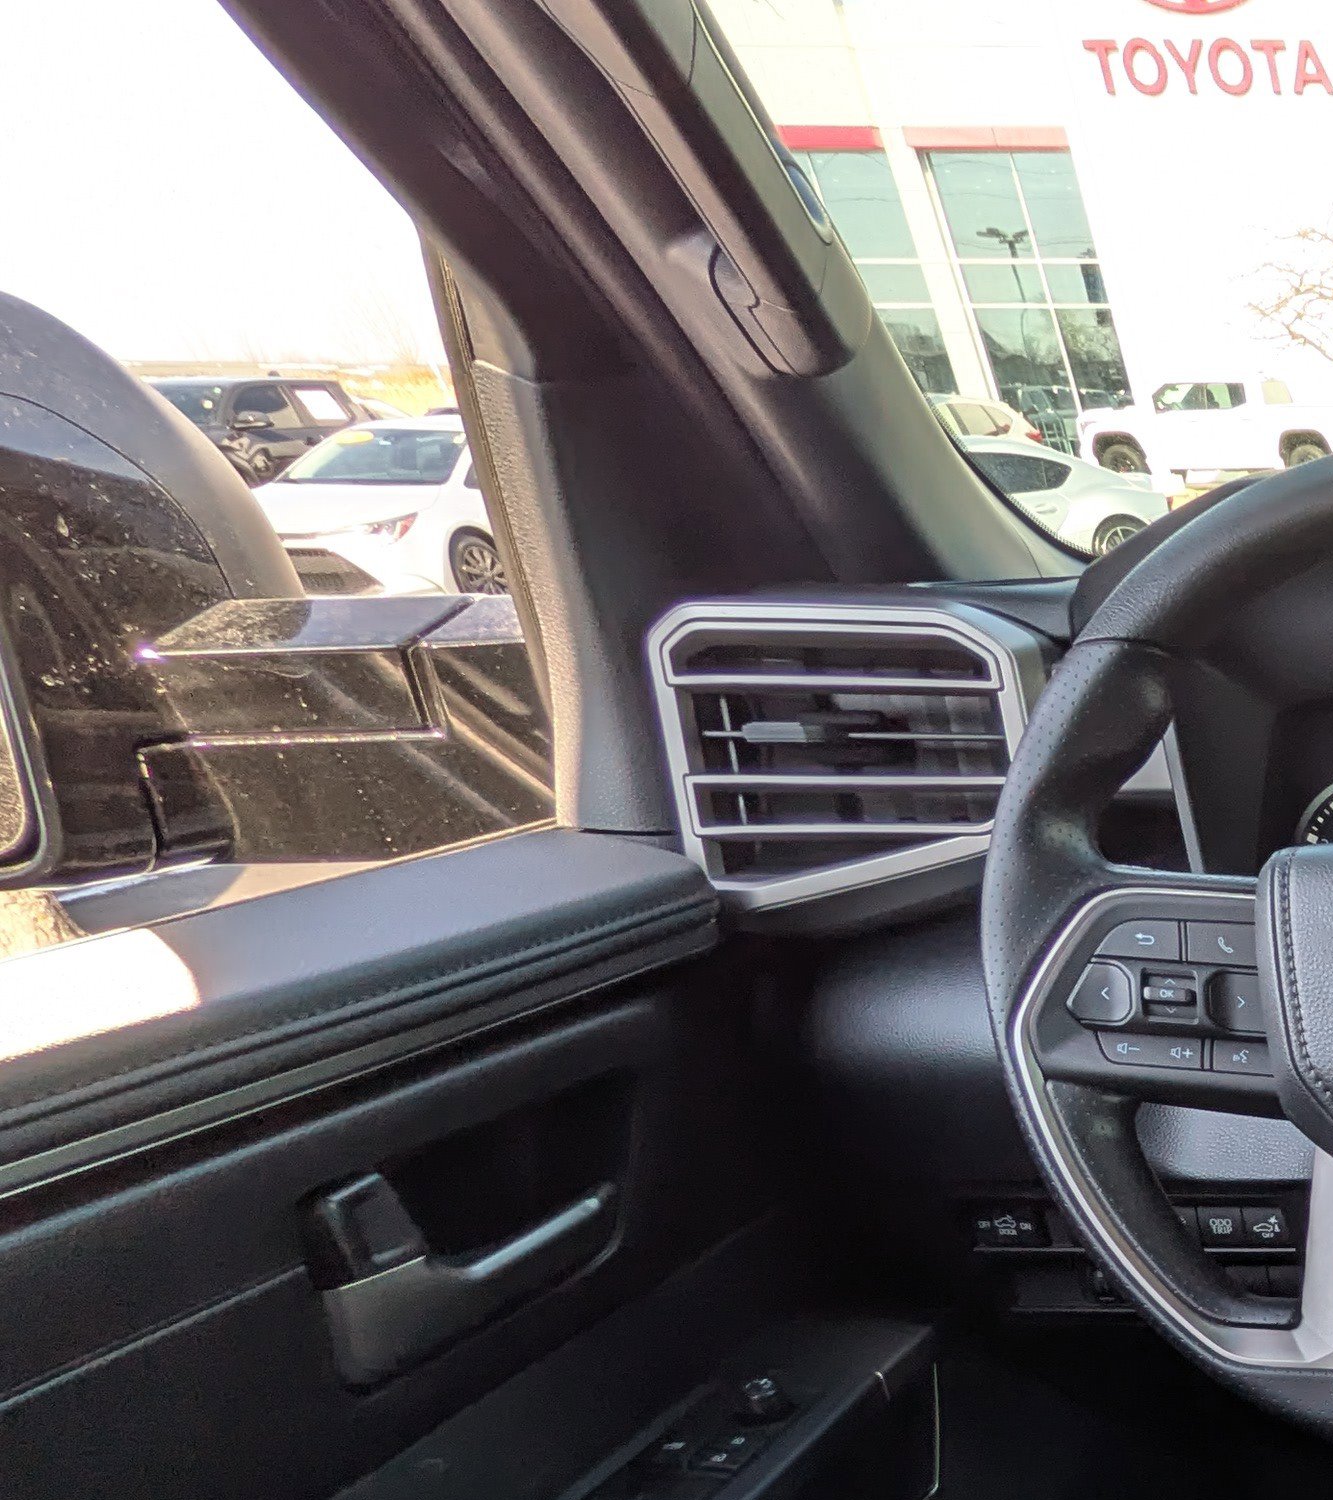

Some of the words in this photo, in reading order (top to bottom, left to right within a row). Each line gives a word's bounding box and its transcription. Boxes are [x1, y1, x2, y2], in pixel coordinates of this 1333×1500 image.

[1159, 989, 1174, 998] OK
[1209, 1218, 1232, 1227] ODO
[1212, 1226, 1233, 1235] TRIP
